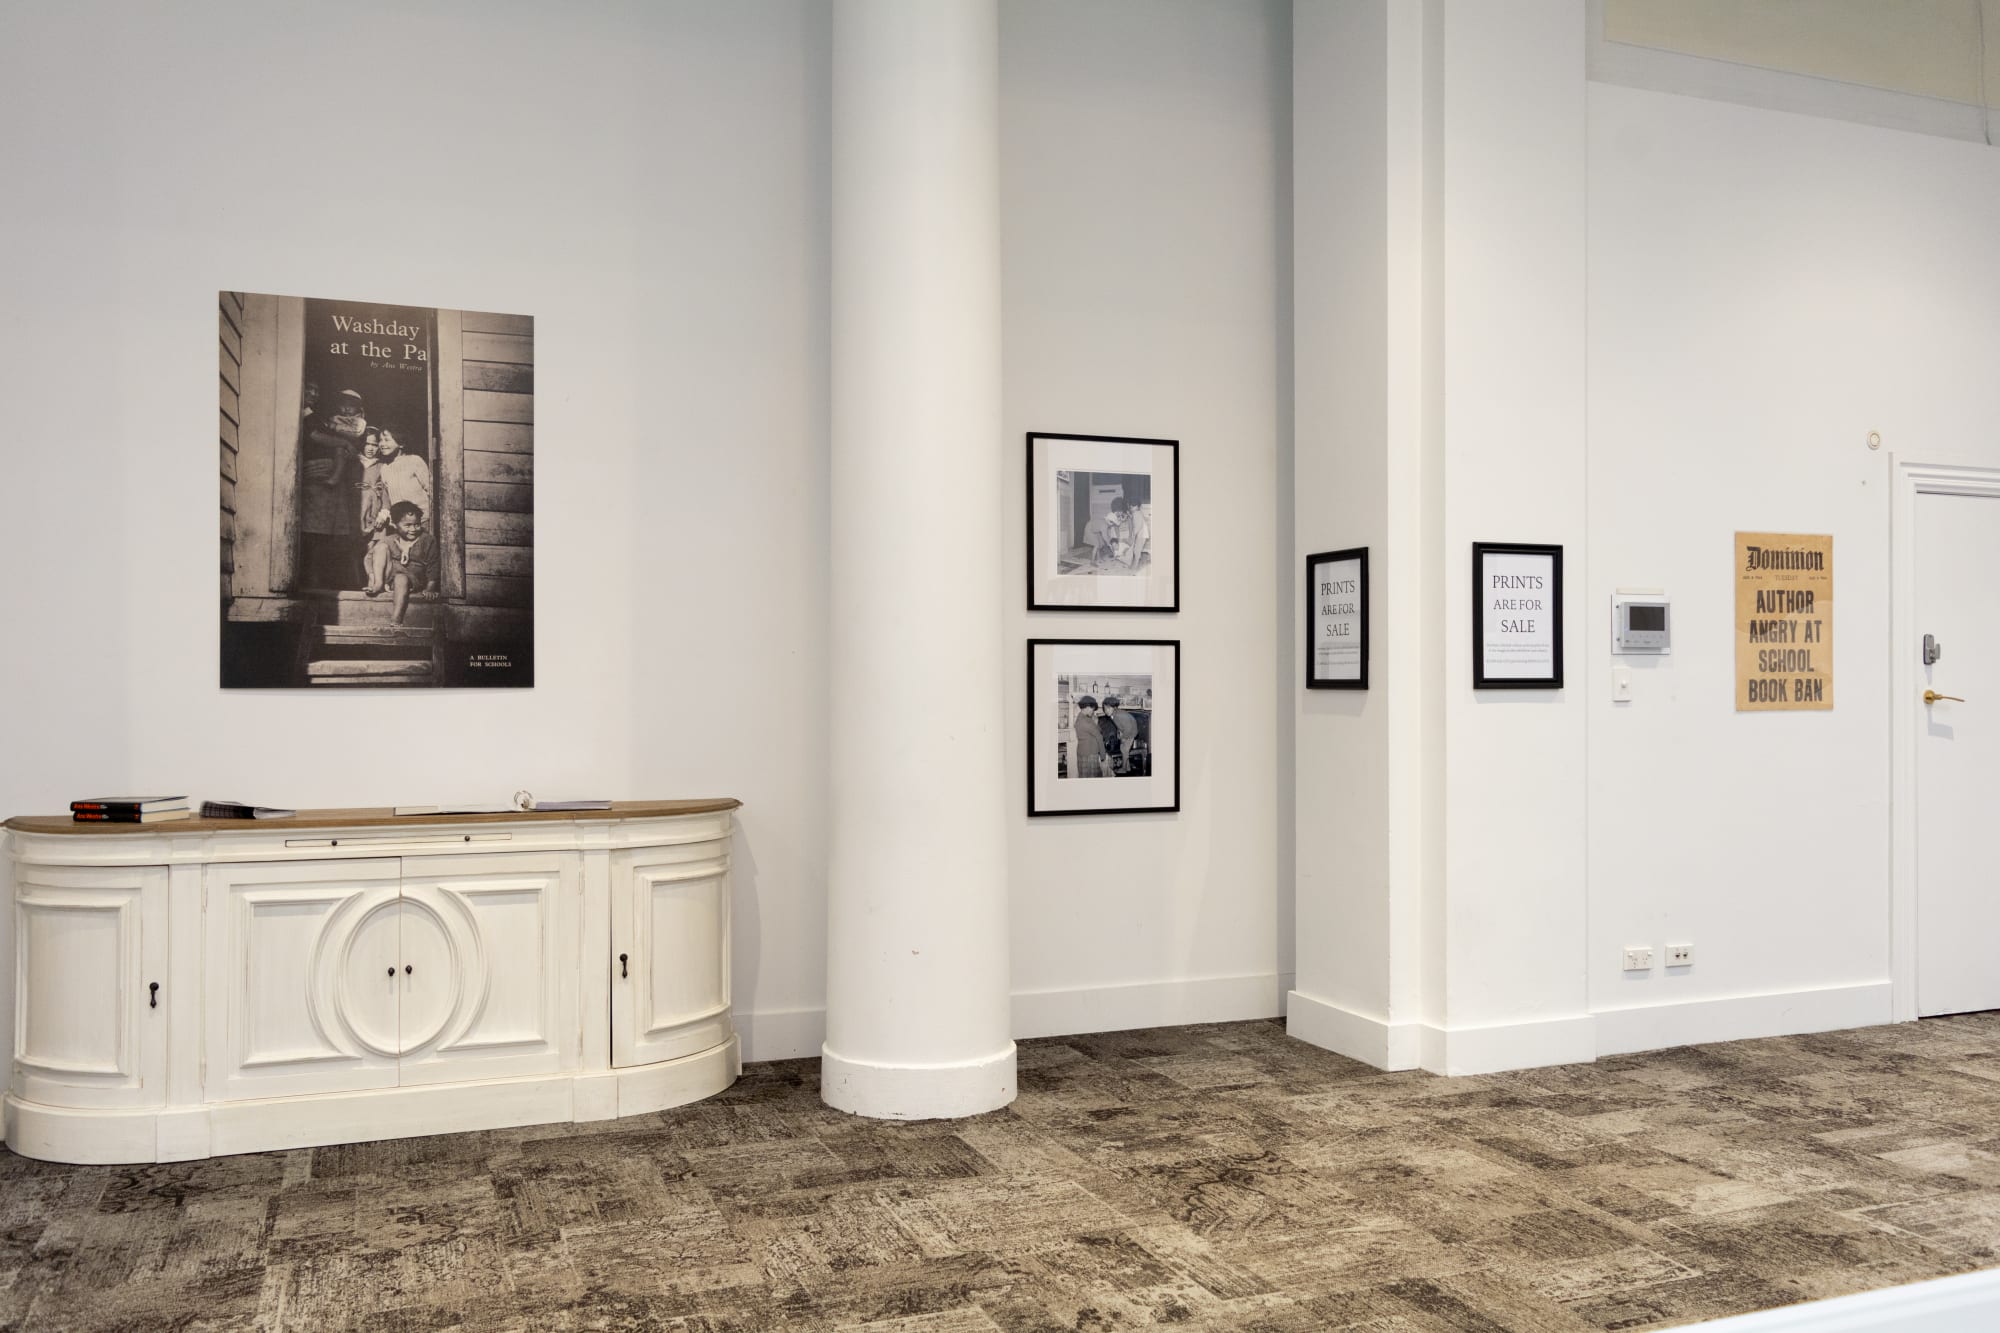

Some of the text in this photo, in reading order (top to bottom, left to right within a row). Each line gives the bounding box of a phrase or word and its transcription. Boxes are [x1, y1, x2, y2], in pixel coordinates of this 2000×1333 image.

[331, 315, 420, 341] Washday
[330, 341, 427, 361] at the Pa
[1745, 546, 1824, 571] Dominion
[1321, 580, 1356, 596] PRINTS
[1492, 575, 1543, 590] PRINTS
[1321, 603, 1355, 616] ARE FOR
[1493, 599, 1542, 611] ARE FOR
[1756, 590, 1815, 614] AUTHOR
[1326, 623, 1350, 637] SALE
[1501, 619, 1536, 633] SALE
[1749, 620, 1822, 643] ANGRY AT
[1758, 649, 1815, 673] SCHOOL
[1749, 679, 1823, 703] BOOK BAN
